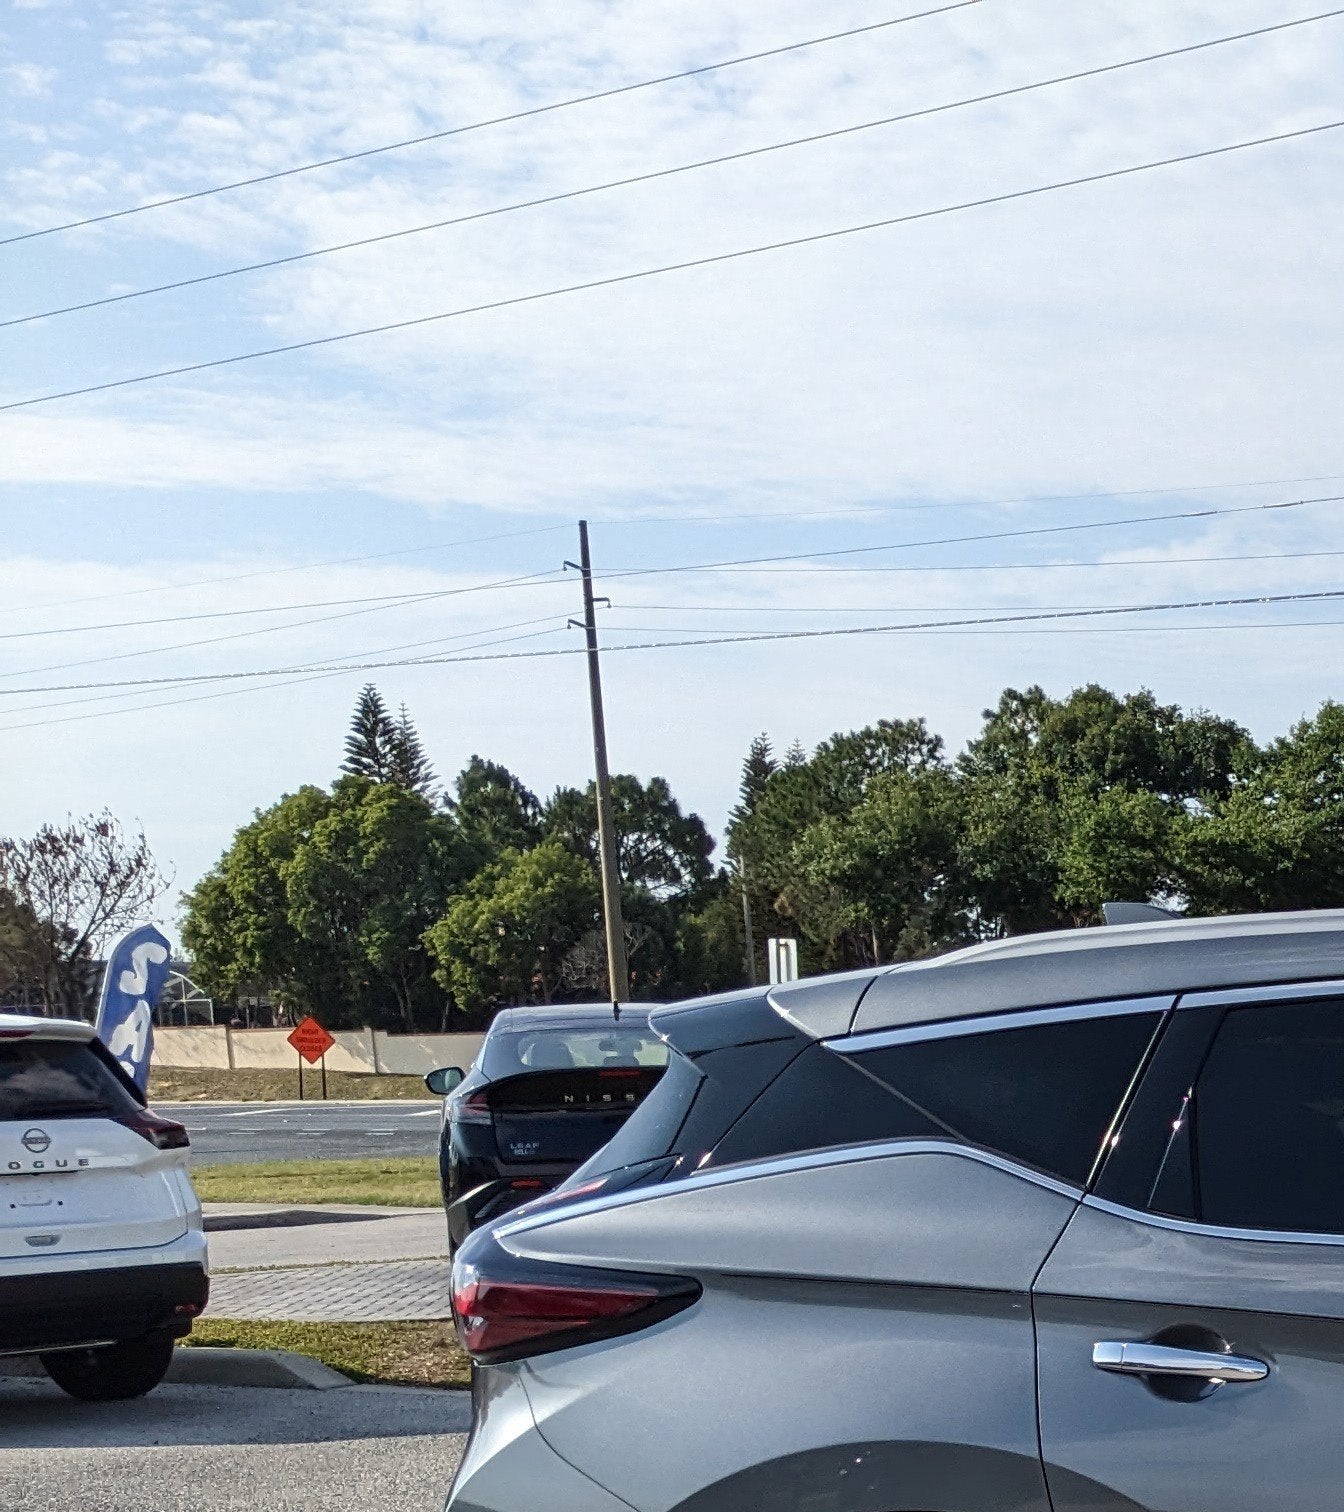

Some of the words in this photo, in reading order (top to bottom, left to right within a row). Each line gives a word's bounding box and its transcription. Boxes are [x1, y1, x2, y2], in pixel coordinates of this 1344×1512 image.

[109, 942, 168, 1078] SA
[564, 1093, 635, 1103] NISS
[8, 1159, 89, 1170] OGUE
